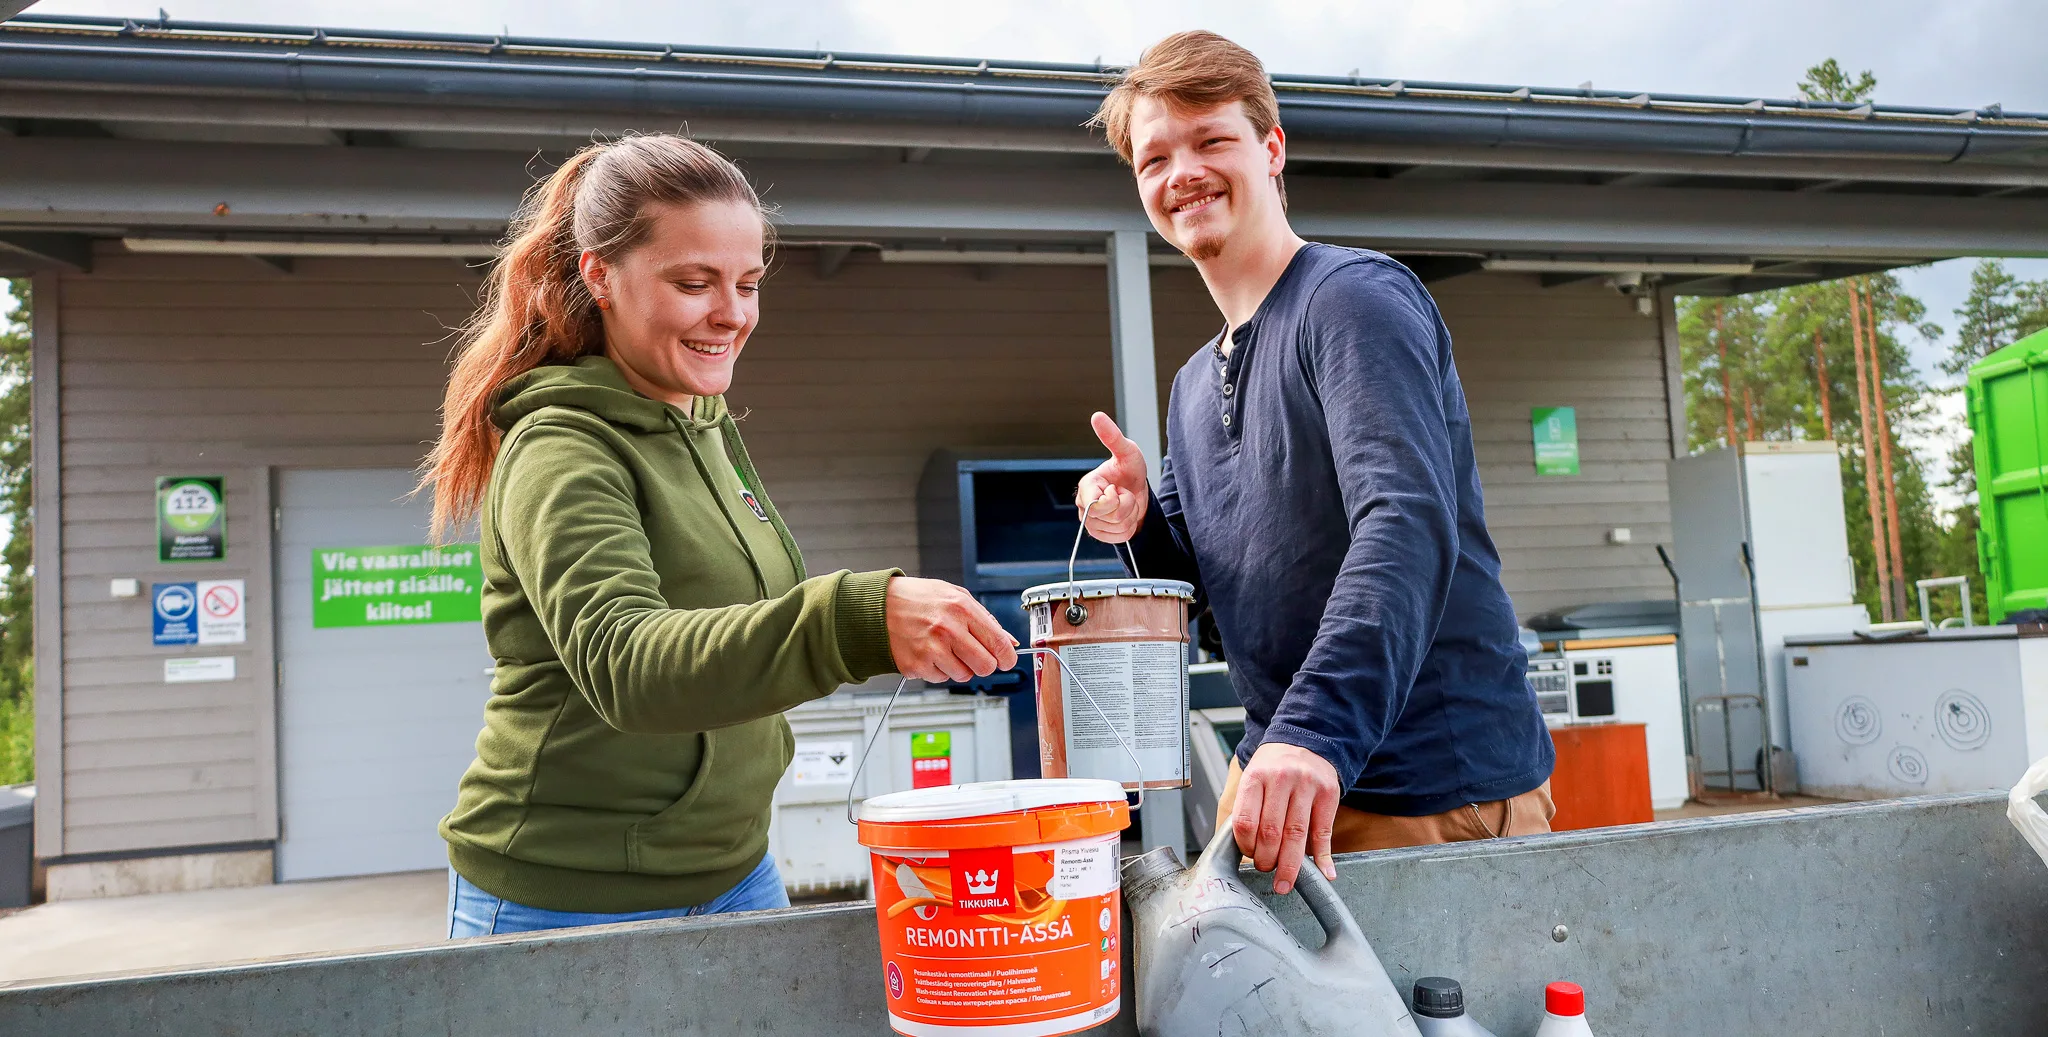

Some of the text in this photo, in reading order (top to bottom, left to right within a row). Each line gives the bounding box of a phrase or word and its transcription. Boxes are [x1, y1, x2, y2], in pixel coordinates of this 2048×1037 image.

[175, 496, 208, 509] 112
[321, 550, 473, 571] Vie vaaralliset
[399, 575, 473, 595] sisälle,
[366, 600, 432, 621] kiitos!
[959, 898, 1010, 909] TIKKURILA
[906, 914, 1074, 948] REMONTTI-ÄSSÄ
[949, 970, 991, 978] remonttimaali
[996, 967, 1038, 977] Puolihimmeä
[954, 979, 1002, 988] renoveringsfärg
[1007, 976, 1037, 985] Halvmatt
[915, 988, 953, 997] Wash-resistant
[953, 989, 988, 997] Renovation
[1009, 985, 1042, 995] Semi-matt
[1005, 996, 1028, 1006] краска
[1032, 991, 1071, 1001] Полуматовая
